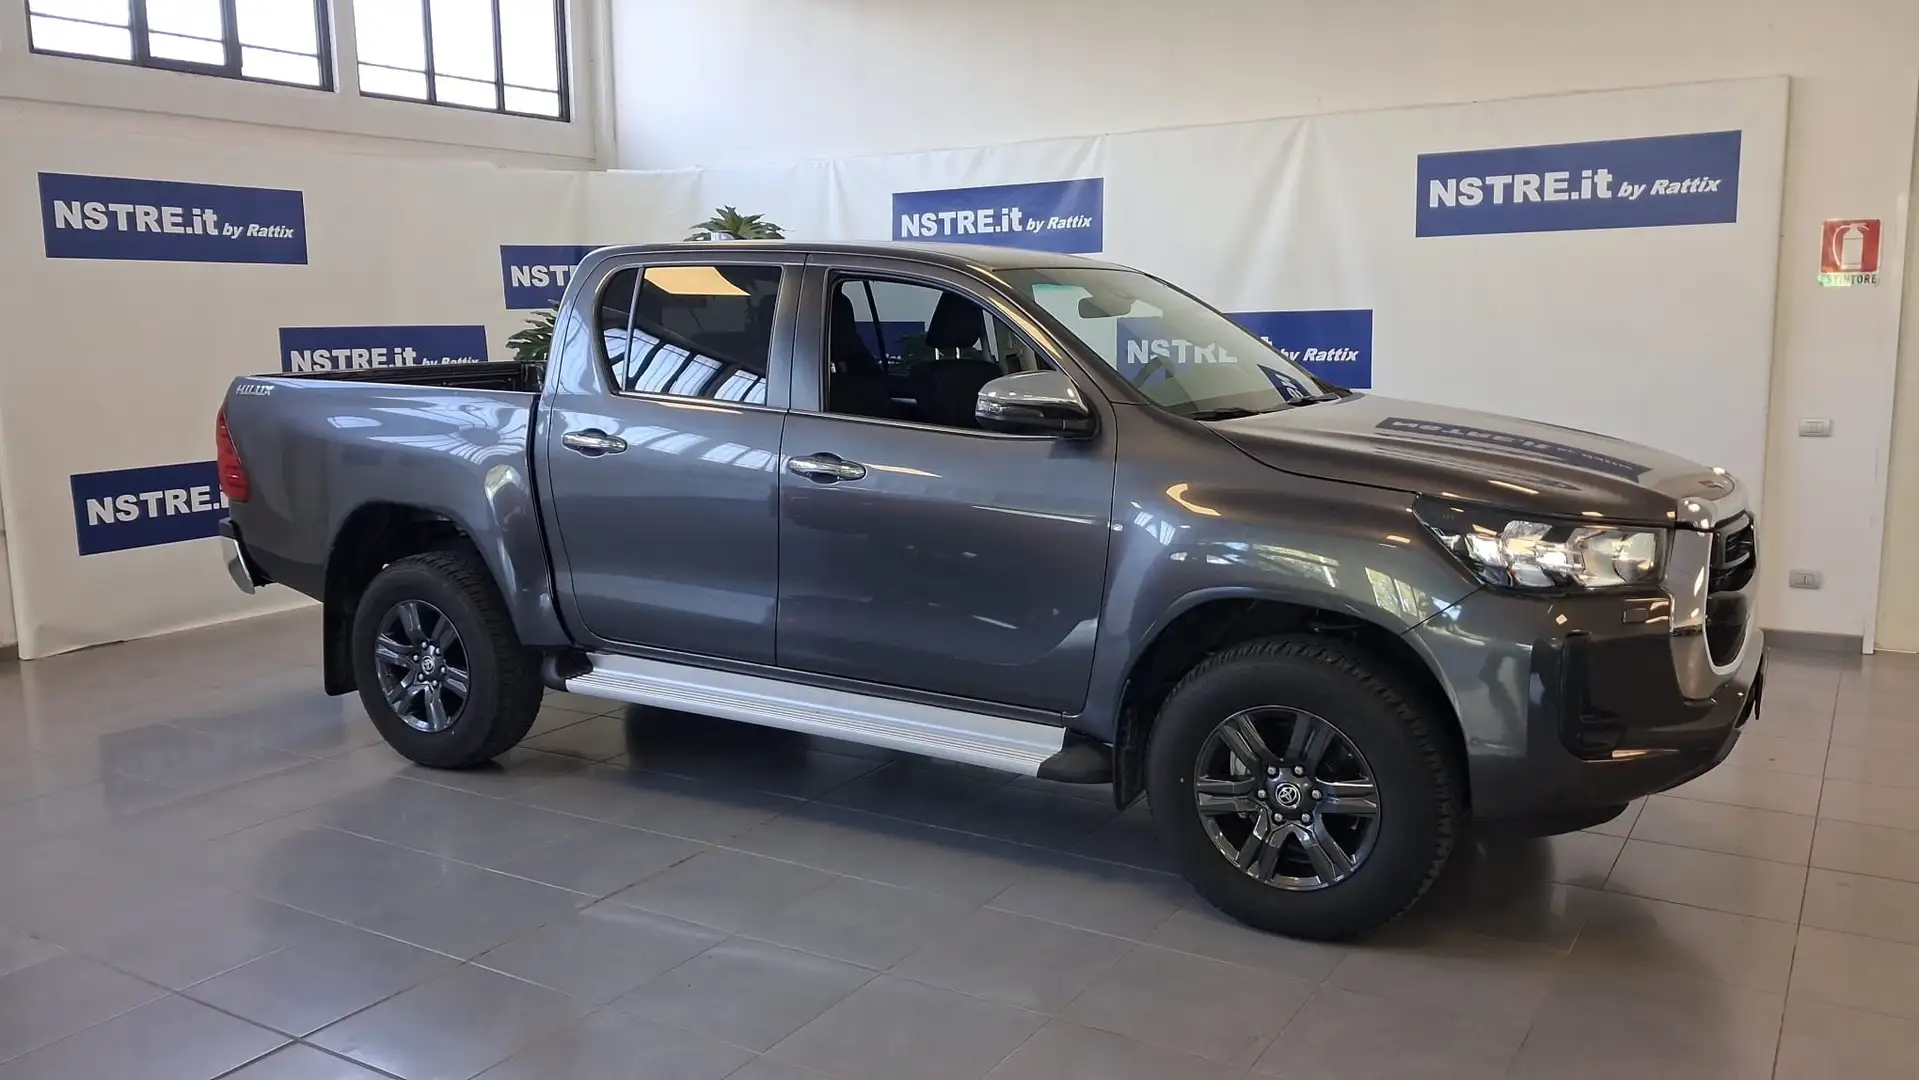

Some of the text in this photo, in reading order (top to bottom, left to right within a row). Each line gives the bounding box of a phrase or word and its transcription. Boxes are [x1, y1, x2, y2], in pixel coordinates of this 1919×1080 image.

[1429, 168, 1723, 208] NSTRE.it by Rattix
[53, 200, 295, 240] NSTRE.it by Rattix
[901, 207, 1093, 238] NSTRE.it by Rattix
[290, 346, 417, 373] NSTRE.it
[1302, 347, 1359, 362] Rattix
[235, 384, 275, 397] HILUX
[86, 484, 229, 526] NSTRE.i
